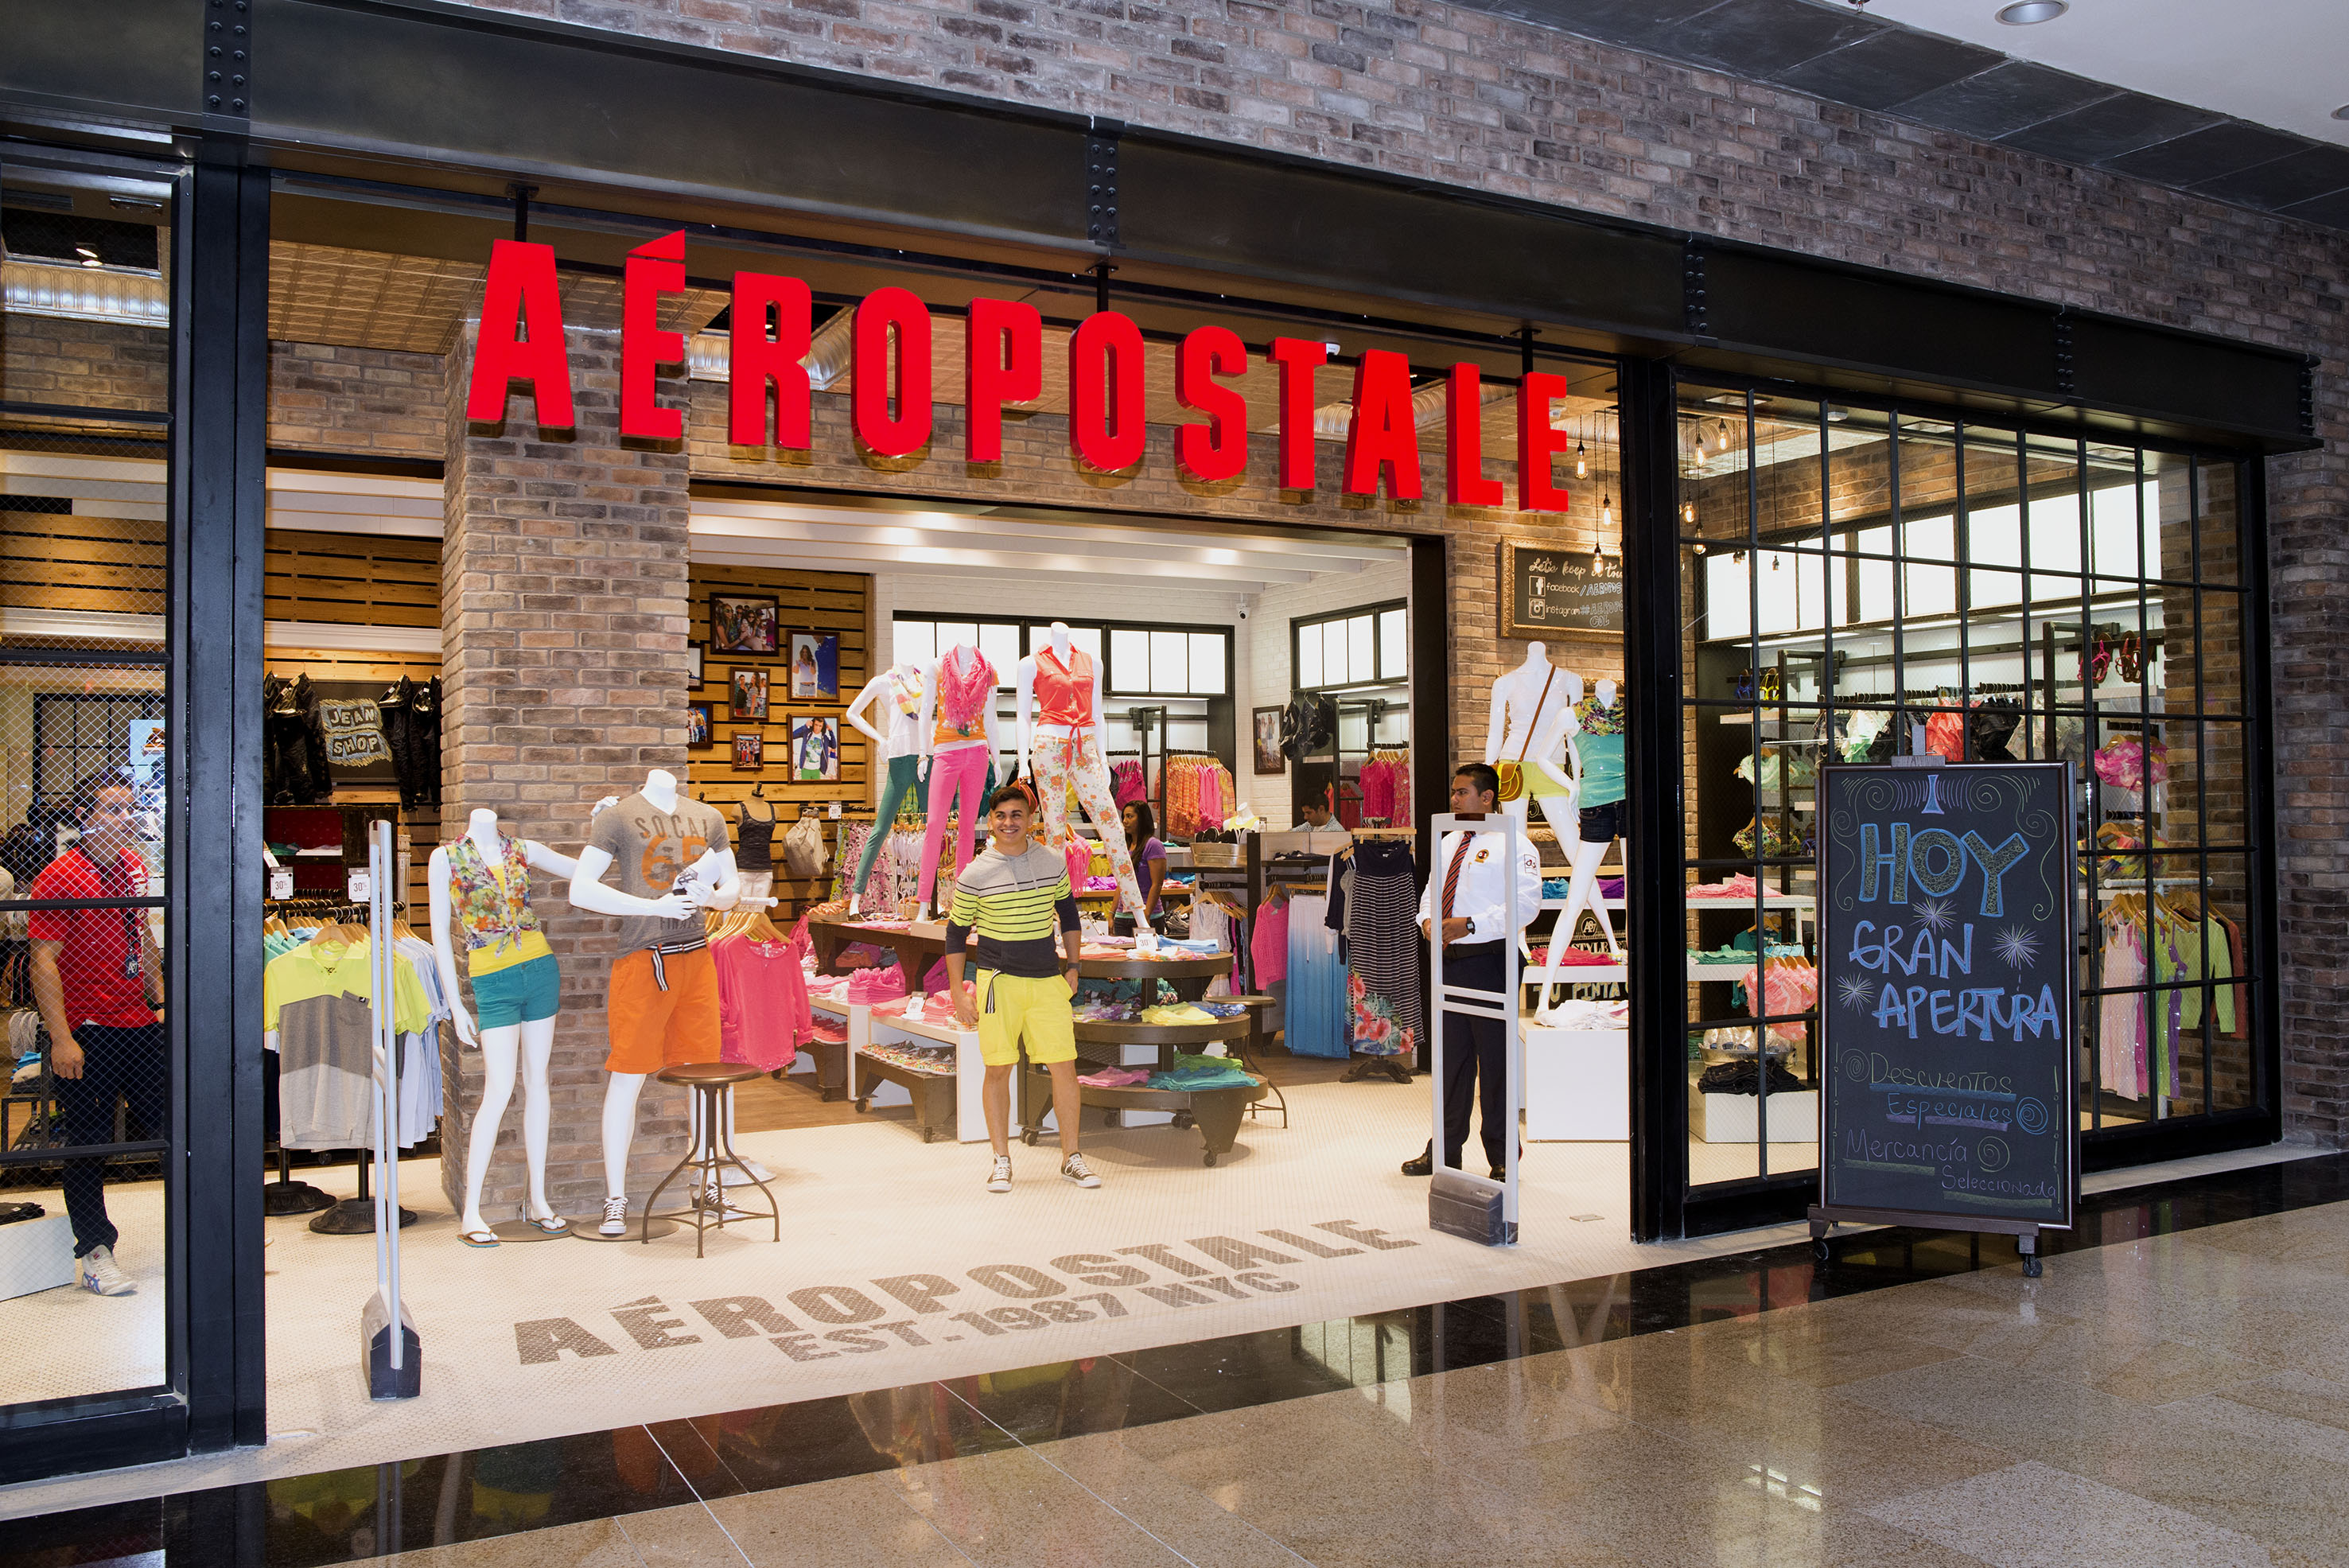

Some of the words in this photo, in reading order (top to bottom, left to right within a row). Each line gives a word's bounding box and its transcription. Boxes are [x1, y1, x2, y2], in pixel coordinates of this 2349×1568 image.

[466, 230, 1569, 512] AÉROPOSTALE
[330, 709, 375, 724] JEAN
[333, 737, 378, 754] SHOP
[1859, 823, 2030, 917] HOY
[1849, 920, 1974, 979] GRAN
[1572, 982, 1621, 1001] PINTA
[1872, 982, 2062, 1042] APERTURA
[1887, 1092, 2013, 1130] Especiales
[1846, 1128, 1968, 1162] Mercancía
[514, 1219, 1421, 1366] AÉROPOSTALE
[1135, 1272, 1301, 1317] NYC
